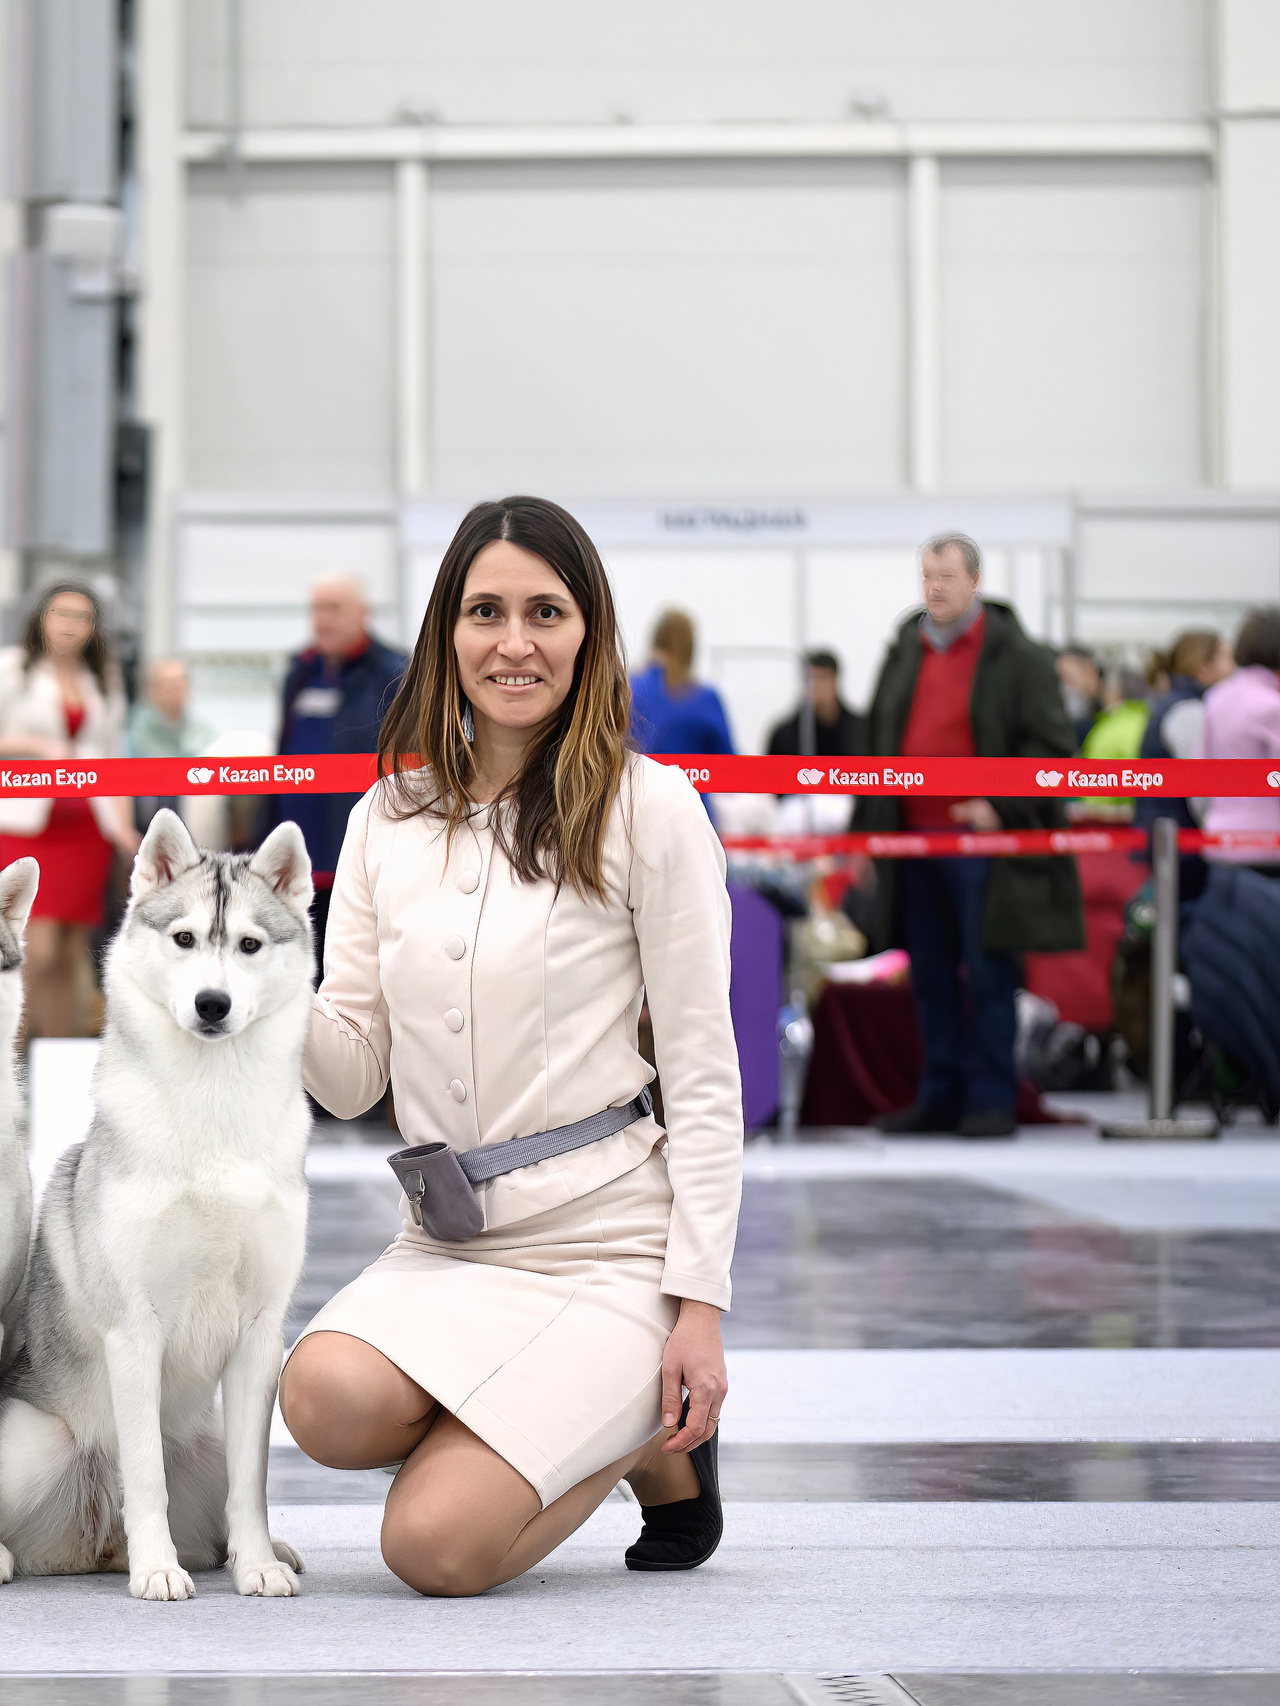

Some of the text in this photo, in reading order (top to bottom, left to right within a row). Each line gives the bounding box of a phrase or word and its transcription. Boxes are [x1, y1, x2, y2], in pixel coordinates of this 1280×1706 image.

[1, 768, 98, 789] Kazan Expo
[220, 764, 315, 786] Kazan Expo
[829, 768, 924, 790] Kazan Expo
[1068, 769, 1164, 791] Kazan Expo
